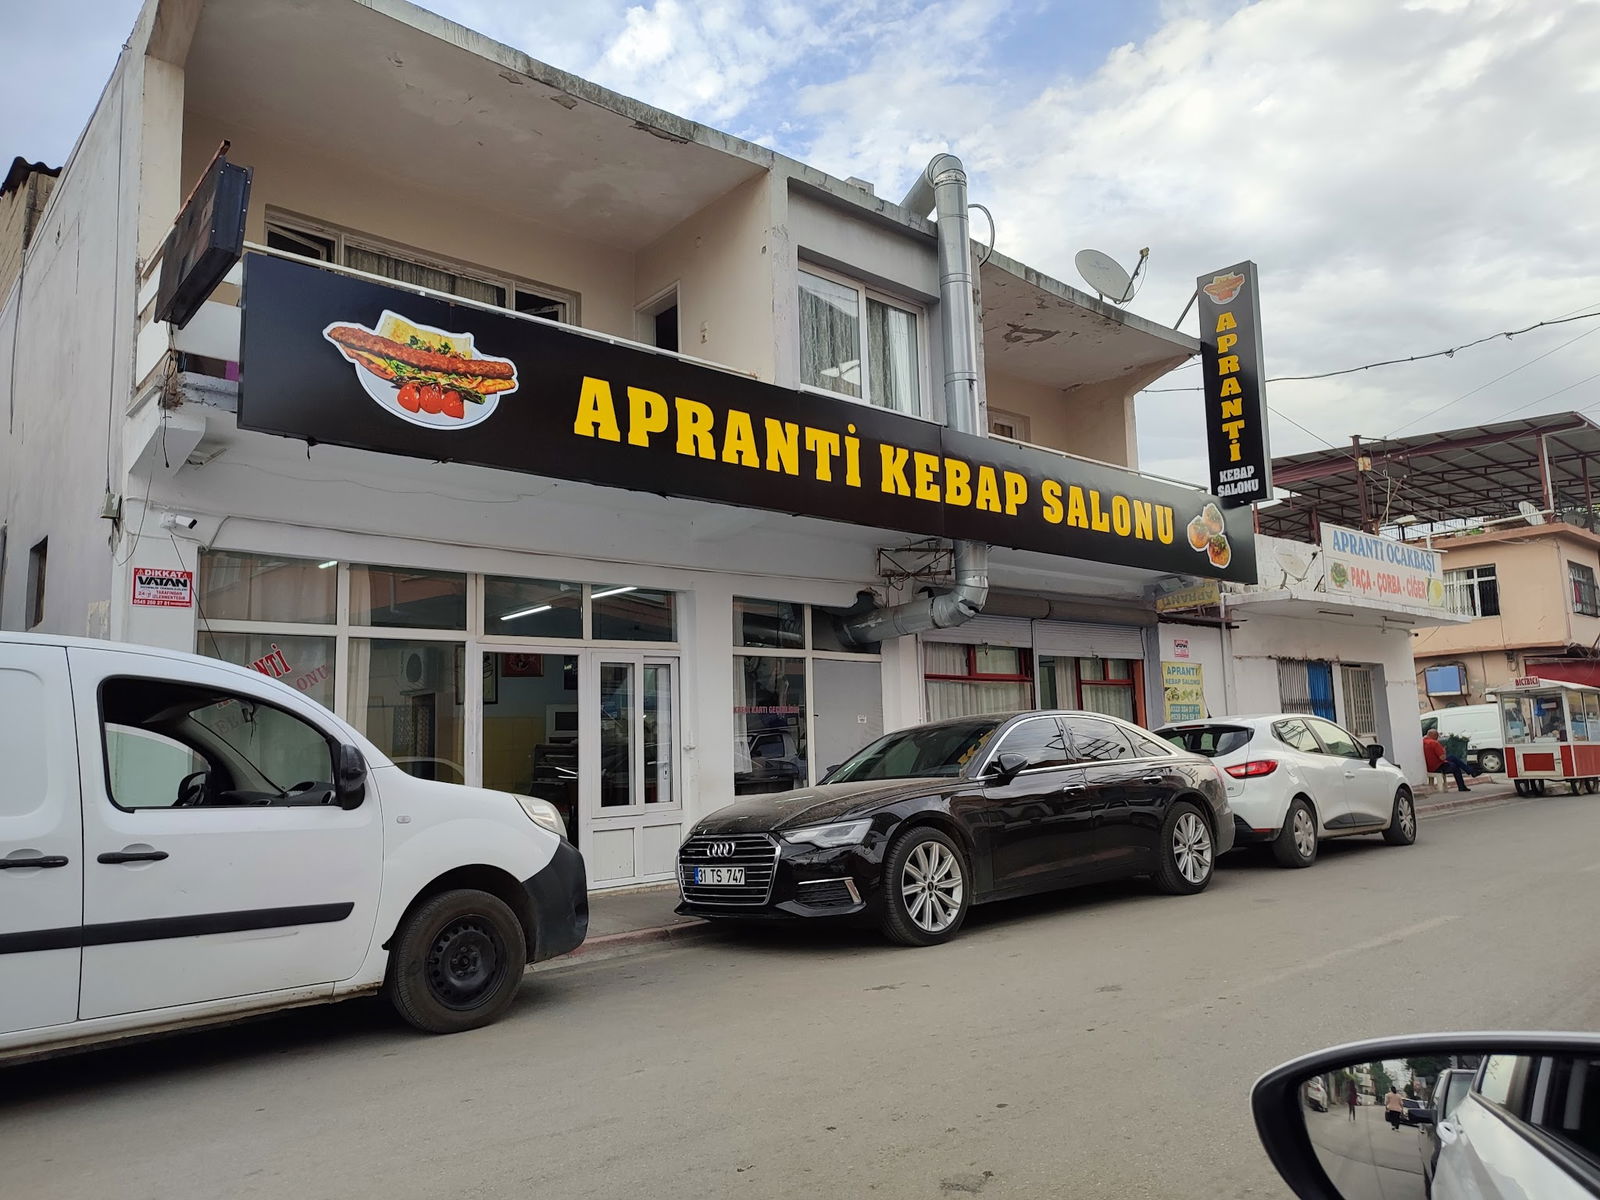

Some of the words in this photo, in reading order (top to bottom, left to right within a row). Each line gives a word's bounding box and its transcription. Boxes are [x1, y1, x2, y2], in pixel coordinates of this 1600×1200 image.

[1216, 311, 1245, 461] APRANTİ
[574, 376, 861, 487] APRANTİ
[879, 444, 1028, 516] KEBAP
[1042, 479, 1174, 545] SALONU
[1219, 465, 1255, 483] KEBAP
[1217, 479, 1259, 497] SALONU
[1386, 543, 1436, 577] OCAKBAŞI
[138, 576, 188, 588] VATAN
[1350, 566, 1372, 594] PAÇA
[1376, 572, 1401, 598] ÇORBA
[699, 869, 707, 883] 31
[710, 869, 722, 883] TS
[727, 869, 744, 883] 747
